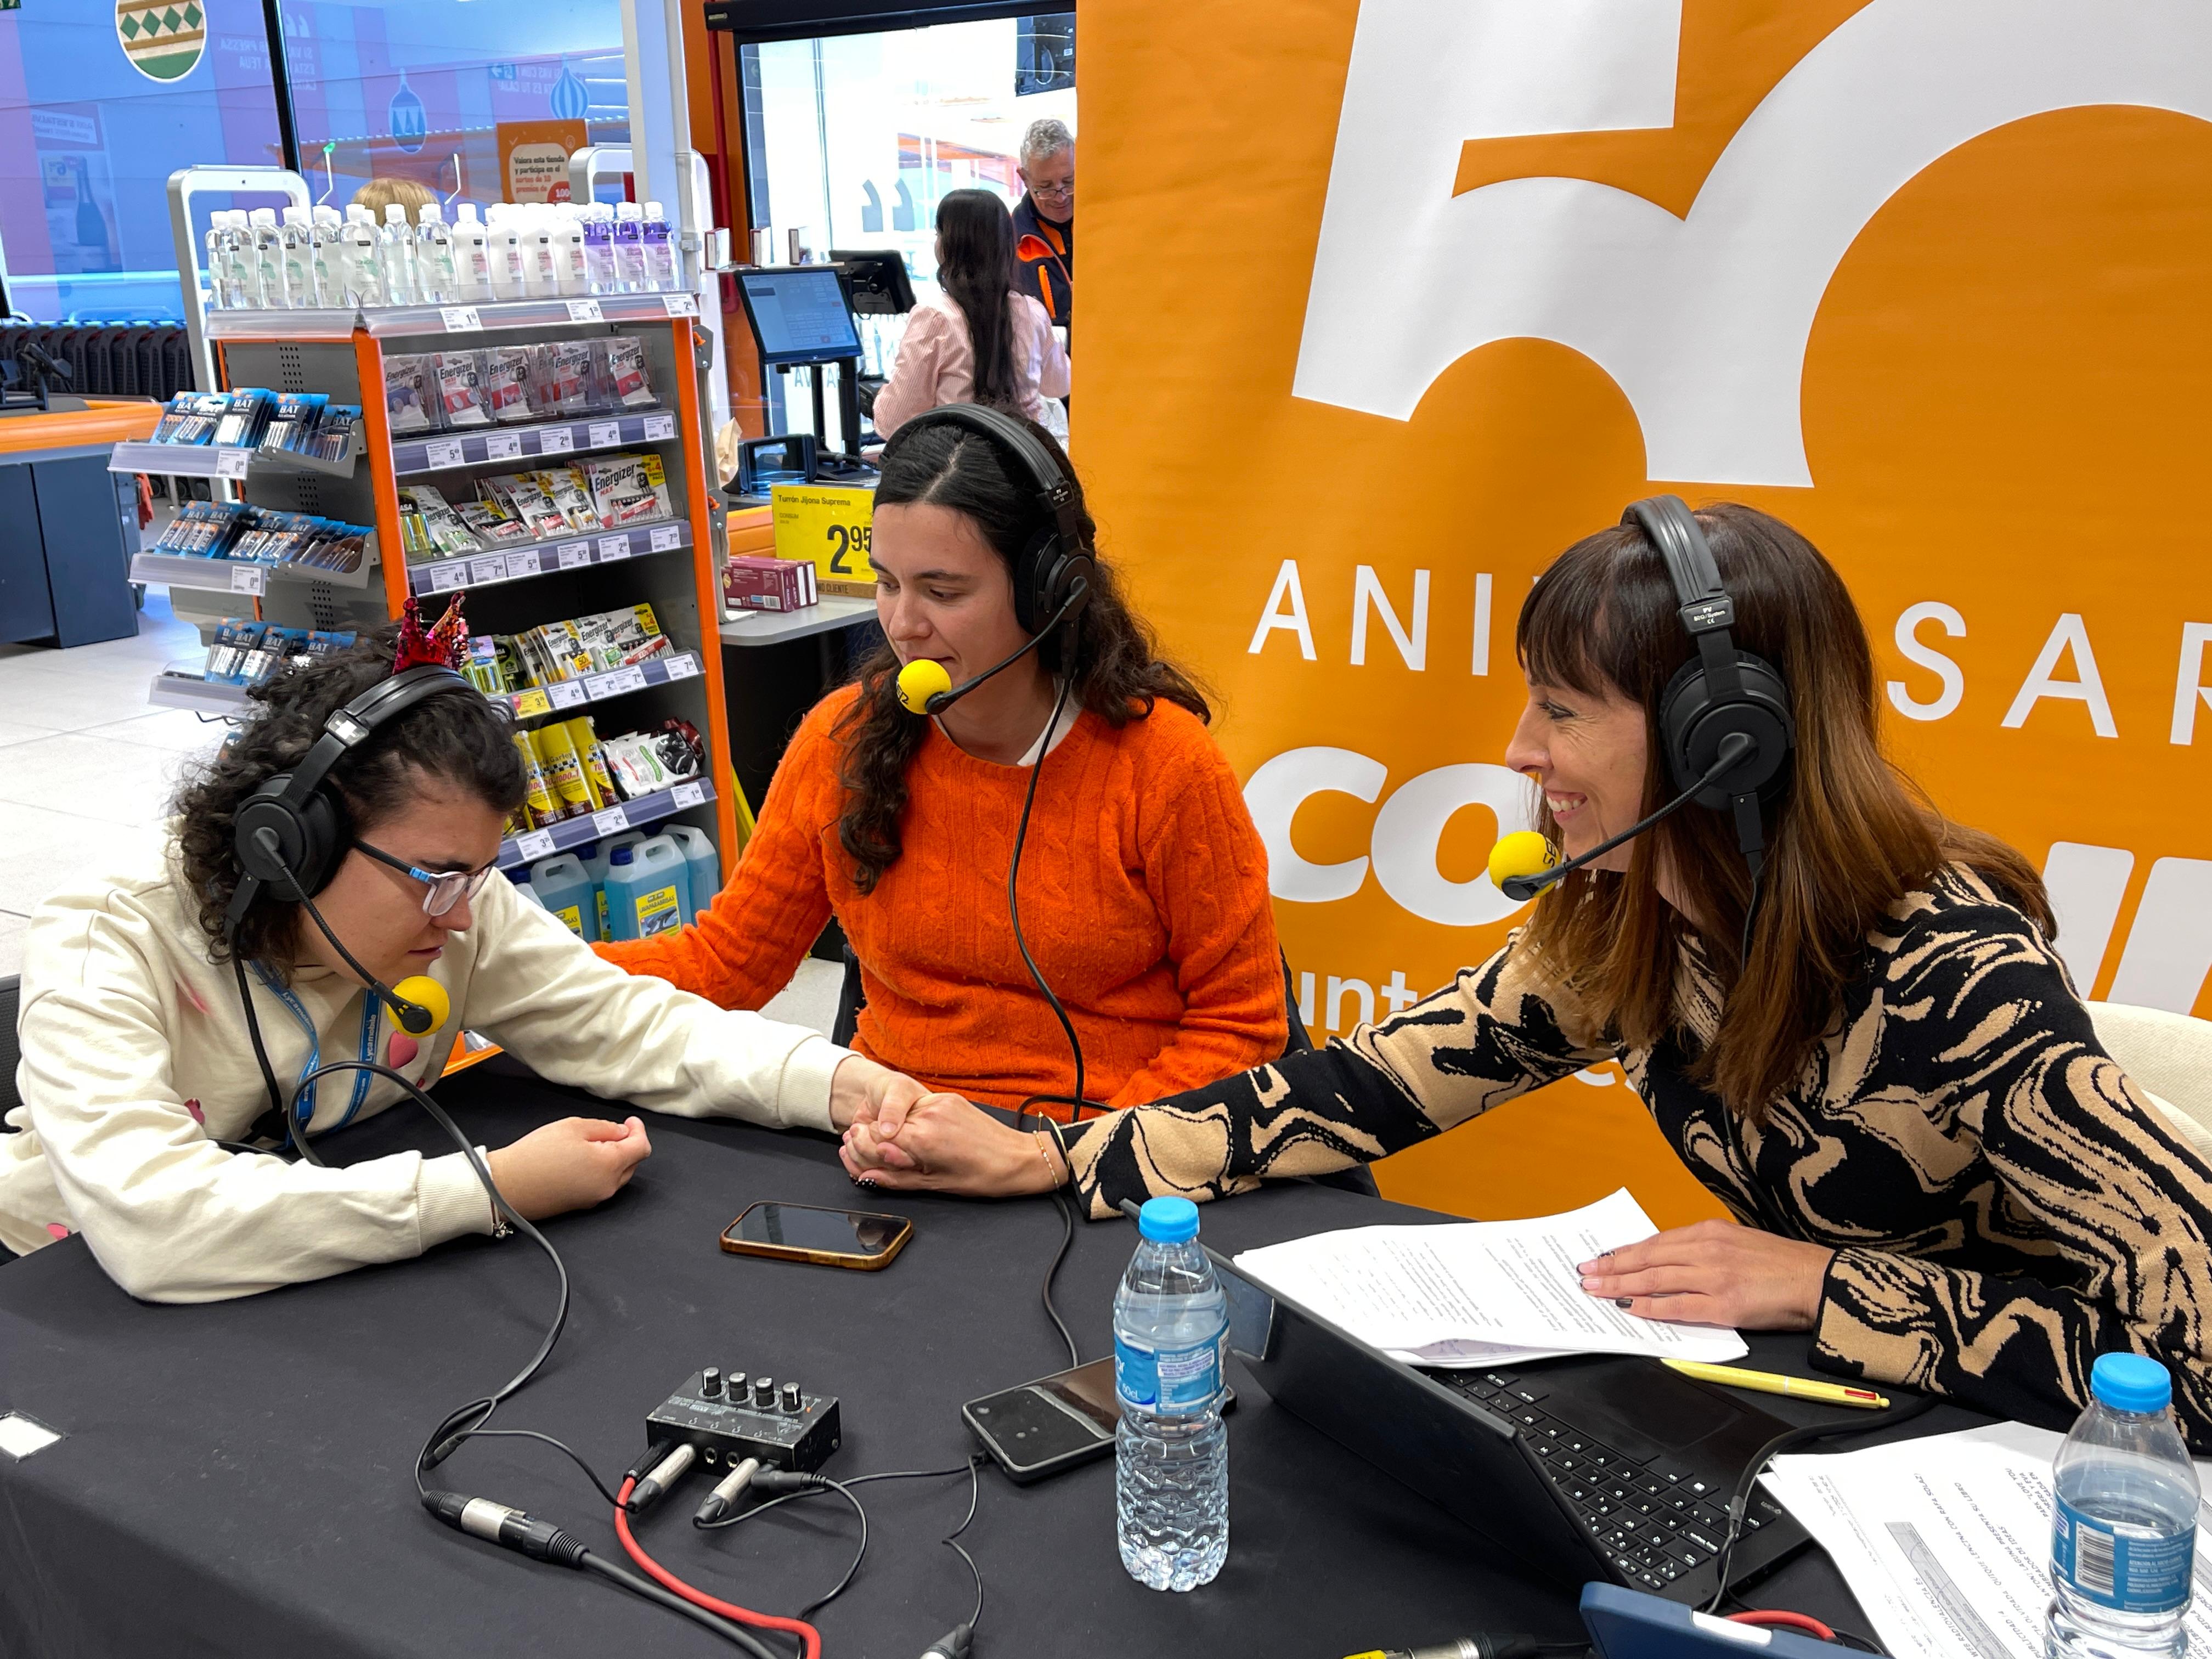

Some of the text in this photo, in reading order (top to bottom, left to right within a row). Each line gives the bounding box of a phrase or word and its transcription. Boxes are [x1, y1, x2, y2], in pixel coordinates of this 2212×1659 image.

[520, 166, 545, 174] participa
[556, 351, 589, 369] Energizer
[612, 346, 640, 365] Energizer
[441, 363, 473, 380] Energizer
[490, 356, 523, 376] Energizer
[233, 398, 254, 409] BAT
[279, 405, 300, 414] BAT
[595, 464, 636, 492] Energizer
[516, 490, 542, 506] Energizer
[778, 494, 851, 506] Turrón Jijona Suprema
[210, 511, 230, 521] BAT
[427, 506, 451, 522] nergizer
[466, 510, 489, 523] Energizer
[290, 523, 311, 533] BAT
[826, 583, 849, 594] CLIENTE
[582, 621, 608, 642] Energizer
[612, 618, 633, 635] nergizer
[235, 633, 254, 642] BAT
[263, 637, 283, 647] BAT
[308, 642, 329, 652] BAT
[550, 752, 573, 763] Garley
[639, 894, 675, 913] LAVAPARABRISAS
[365, 1013, 376, 1062] Lycamobile
[2005, 1468, 2017, 1481] YOU
[2019, 1472, 2032, 1484] EVA
[2029, 1471, 2038, 1480] EN
[1931, 1498, 1946, 1514] RAFA
[2034, 1501, 2049, 1517] PARK
[1944, 1516, 1957, 1530] CON
[1954, 1482, 2050, 1596] ANTONI LAGUNA PRESENTA SU LIBRO
[1955, 1531, 1979, 1559] LENCINA
[2015, 1547, 2025, 1555] DE
[2005, 1619, 2041, 1659] PUBLICIDAD
[1963, 1643, 1978, 1659] WEB
